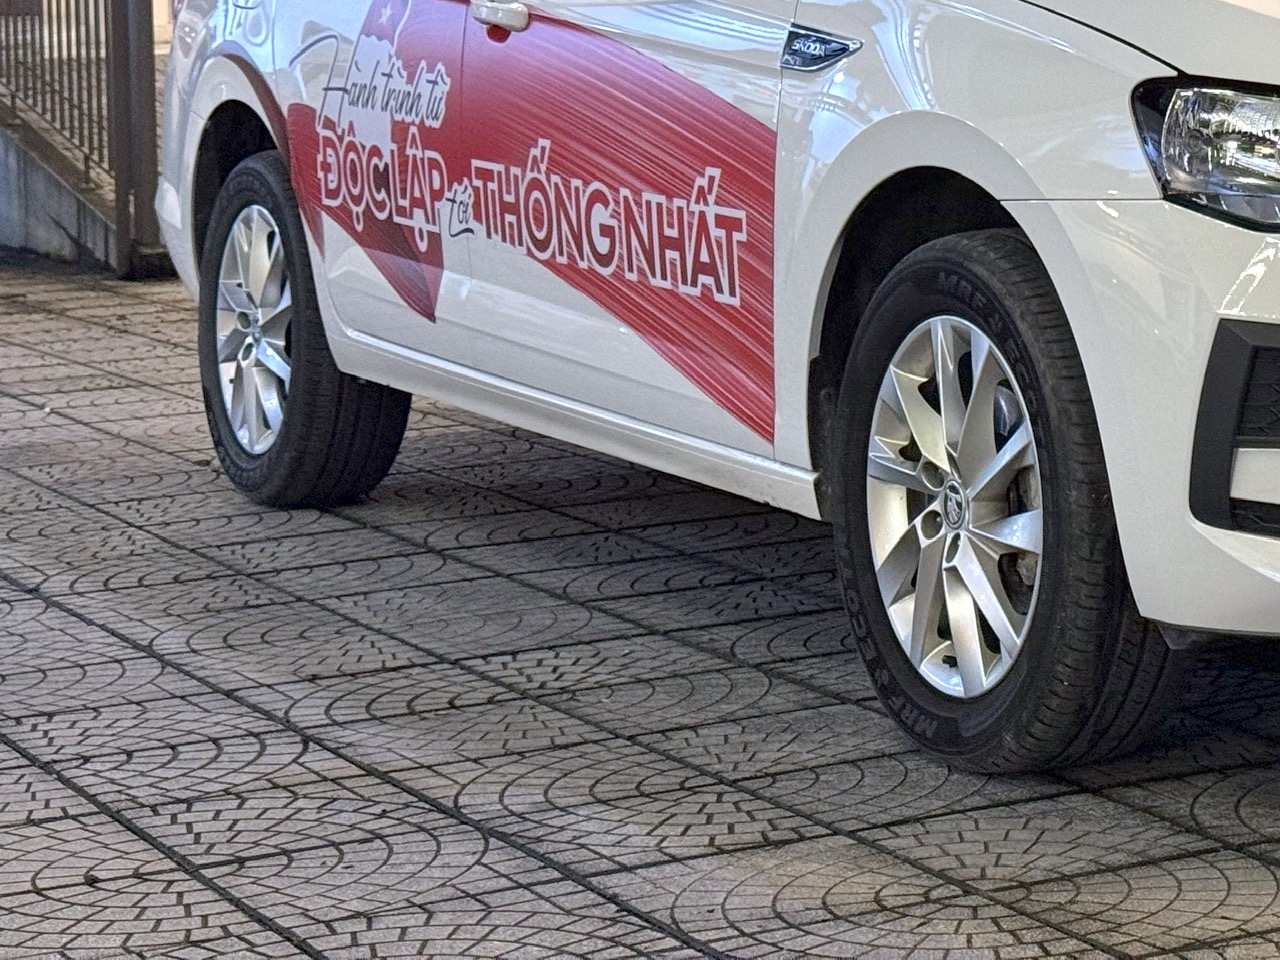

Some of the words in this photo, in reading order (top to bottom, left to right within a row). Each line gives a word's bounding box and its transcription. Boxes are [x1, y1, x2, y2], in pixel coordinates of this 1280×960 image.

[289, 28, 378, 128] Hành
[381, 61, 422, 119] trình
[426, 68, 448, 123] từ
[317, 119, 391, 232] ĐỘC
[390, 125, 448, 252] LẬP
[445, 183, 475, 237] tới
[471, 138, 618, 276] THỐNG
[619, 167, 747, 306] NHẤT
[889, 694, 938, 739] MRF
